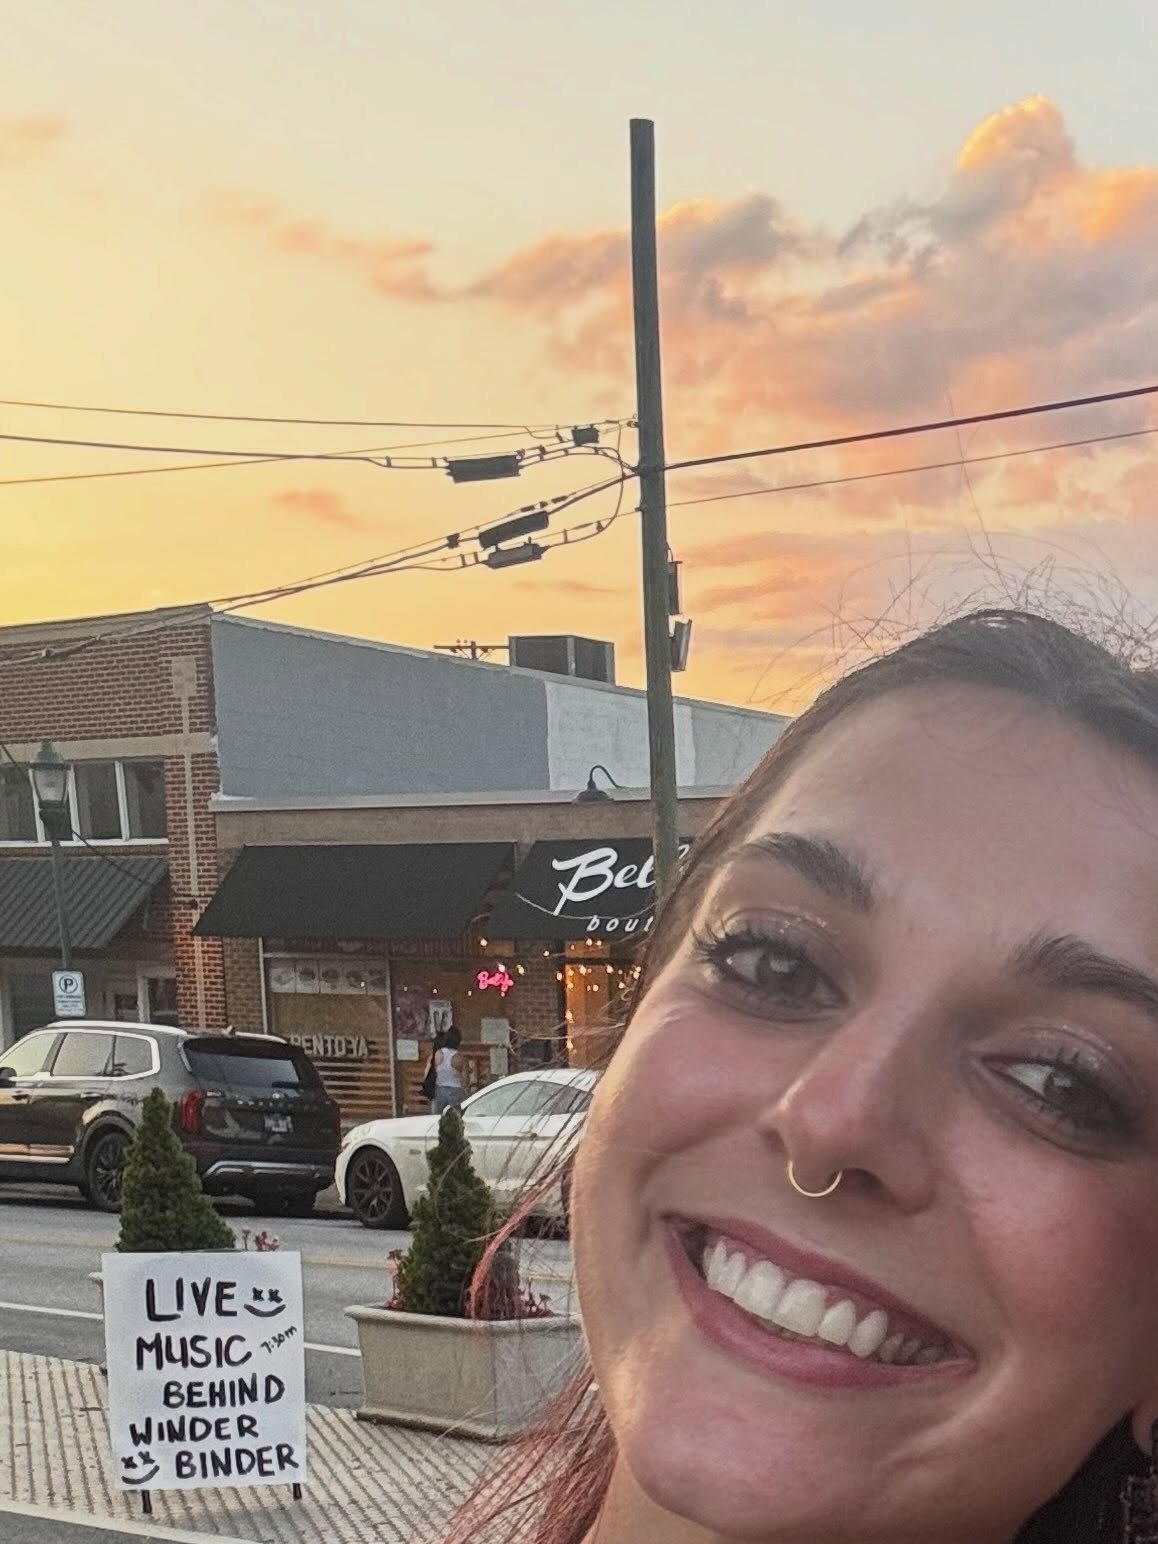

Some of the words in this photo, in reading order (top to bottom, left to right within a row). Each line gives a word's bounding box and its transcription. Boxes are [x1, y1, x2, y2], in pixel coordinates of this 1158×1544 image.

[552, 847, 690, 916] Bel
[586, 915, 655, 932] bout
[146, 1277, 238, 1322] LIVE
[136, 1332, 252, 1370] MUSIC
[163, 1372, 285, 1409] BEHIND
[129, 1413, 259, 1446] WINDER
[175, 1443, 300, 1479] BINDER
